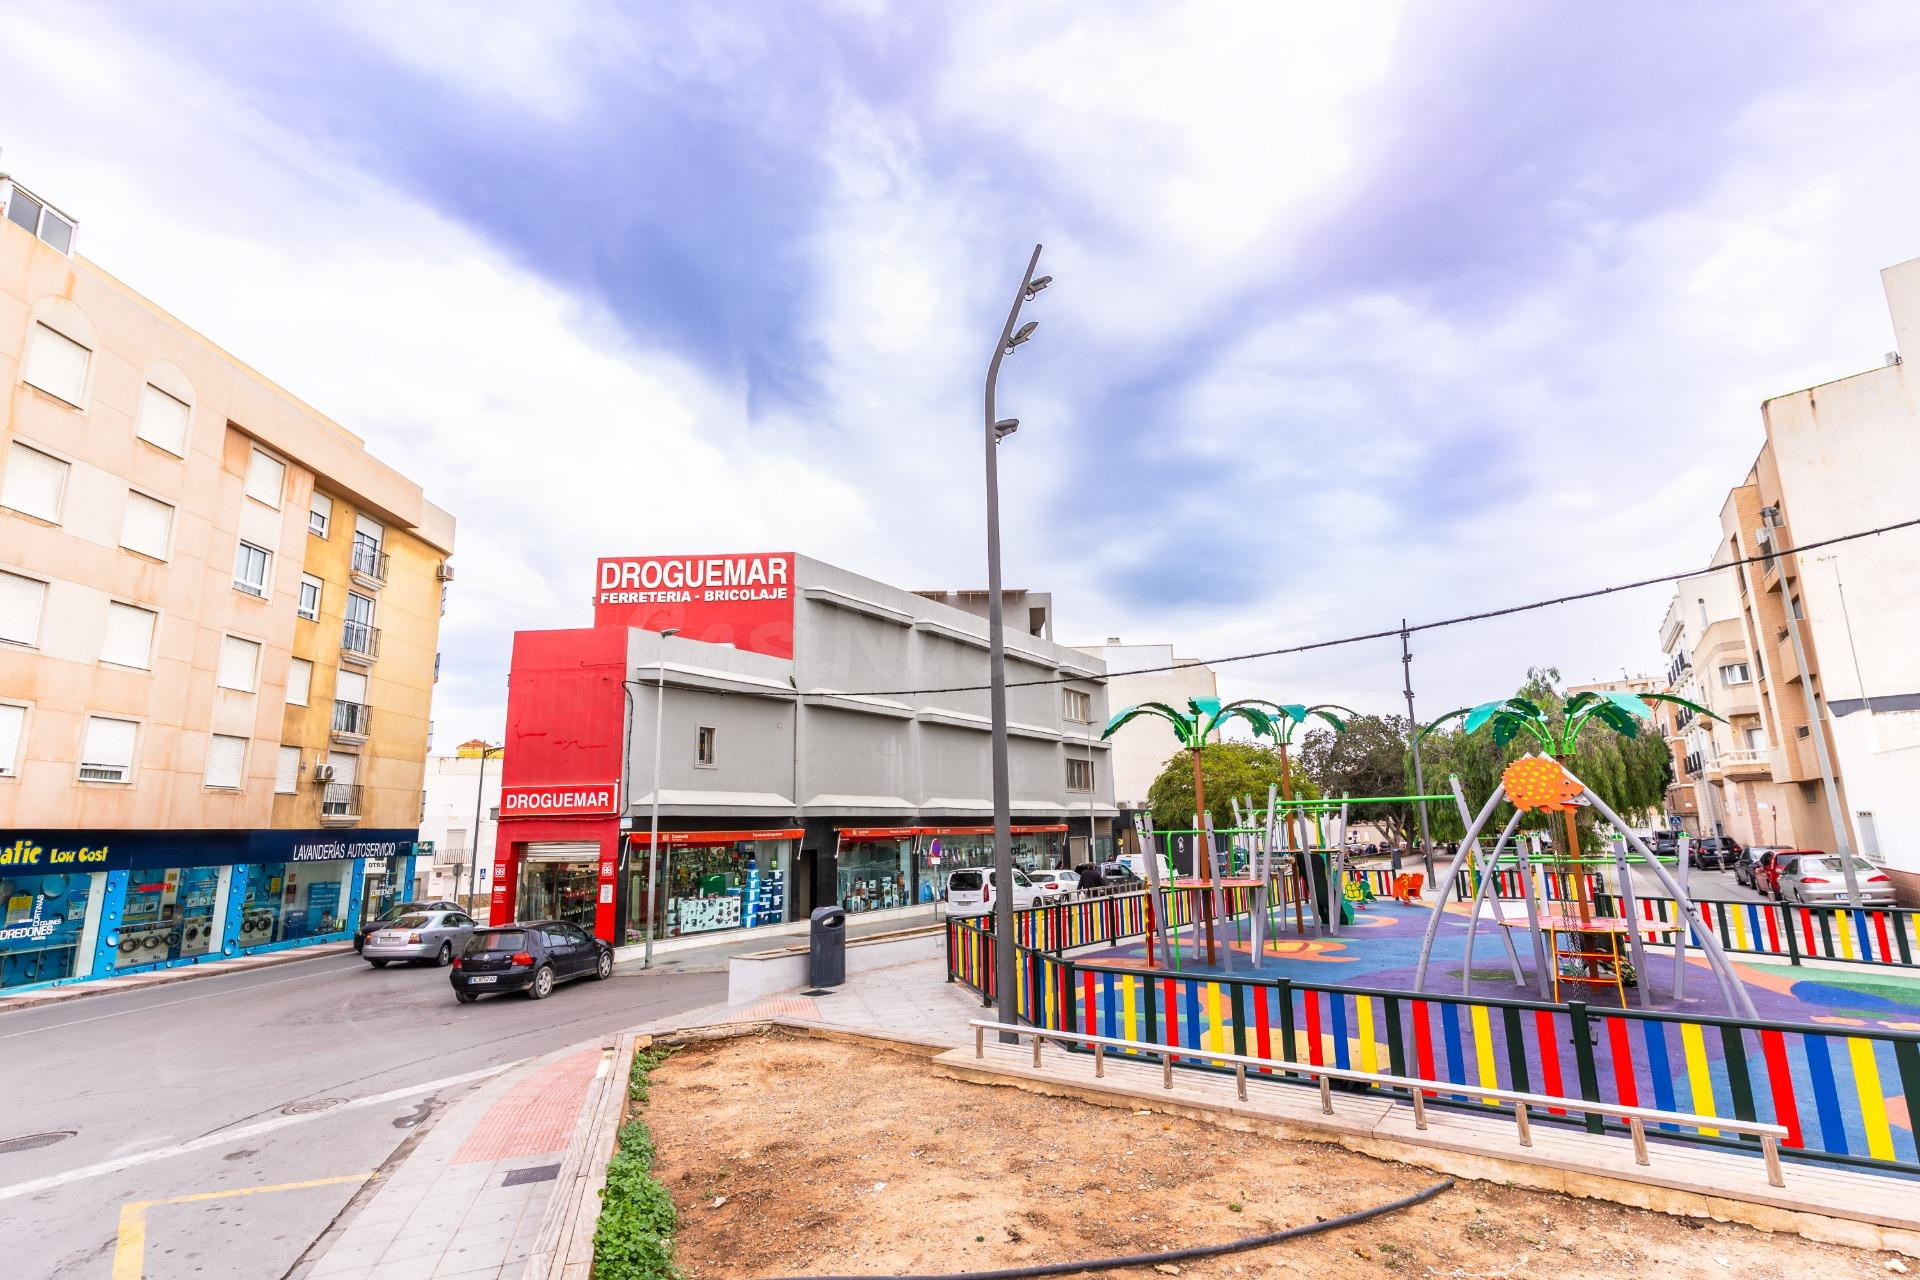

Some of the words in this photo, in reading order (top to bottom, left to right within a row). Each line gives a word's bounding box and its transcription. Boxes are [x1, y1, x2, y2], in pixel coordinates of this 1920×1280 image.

[600, 557, 788, 590] DROGUEMAR
[600, 591, 692, 604] FERRETERIA
[704, 588, 788, 602] BRICOLAJE
[506, 791, 609, 809] DROGUEMAR
[0, 840, 42, 865] atic
[78, 847, 109, 862] Cost
[293, 841, 345, 861] LAVANDERÍAS
[347, 842, 396, 859] AUTOSERVICIO
[33, 894, 44, 927] CORTINAS
[0, 925, 53, 940] DREDONES
